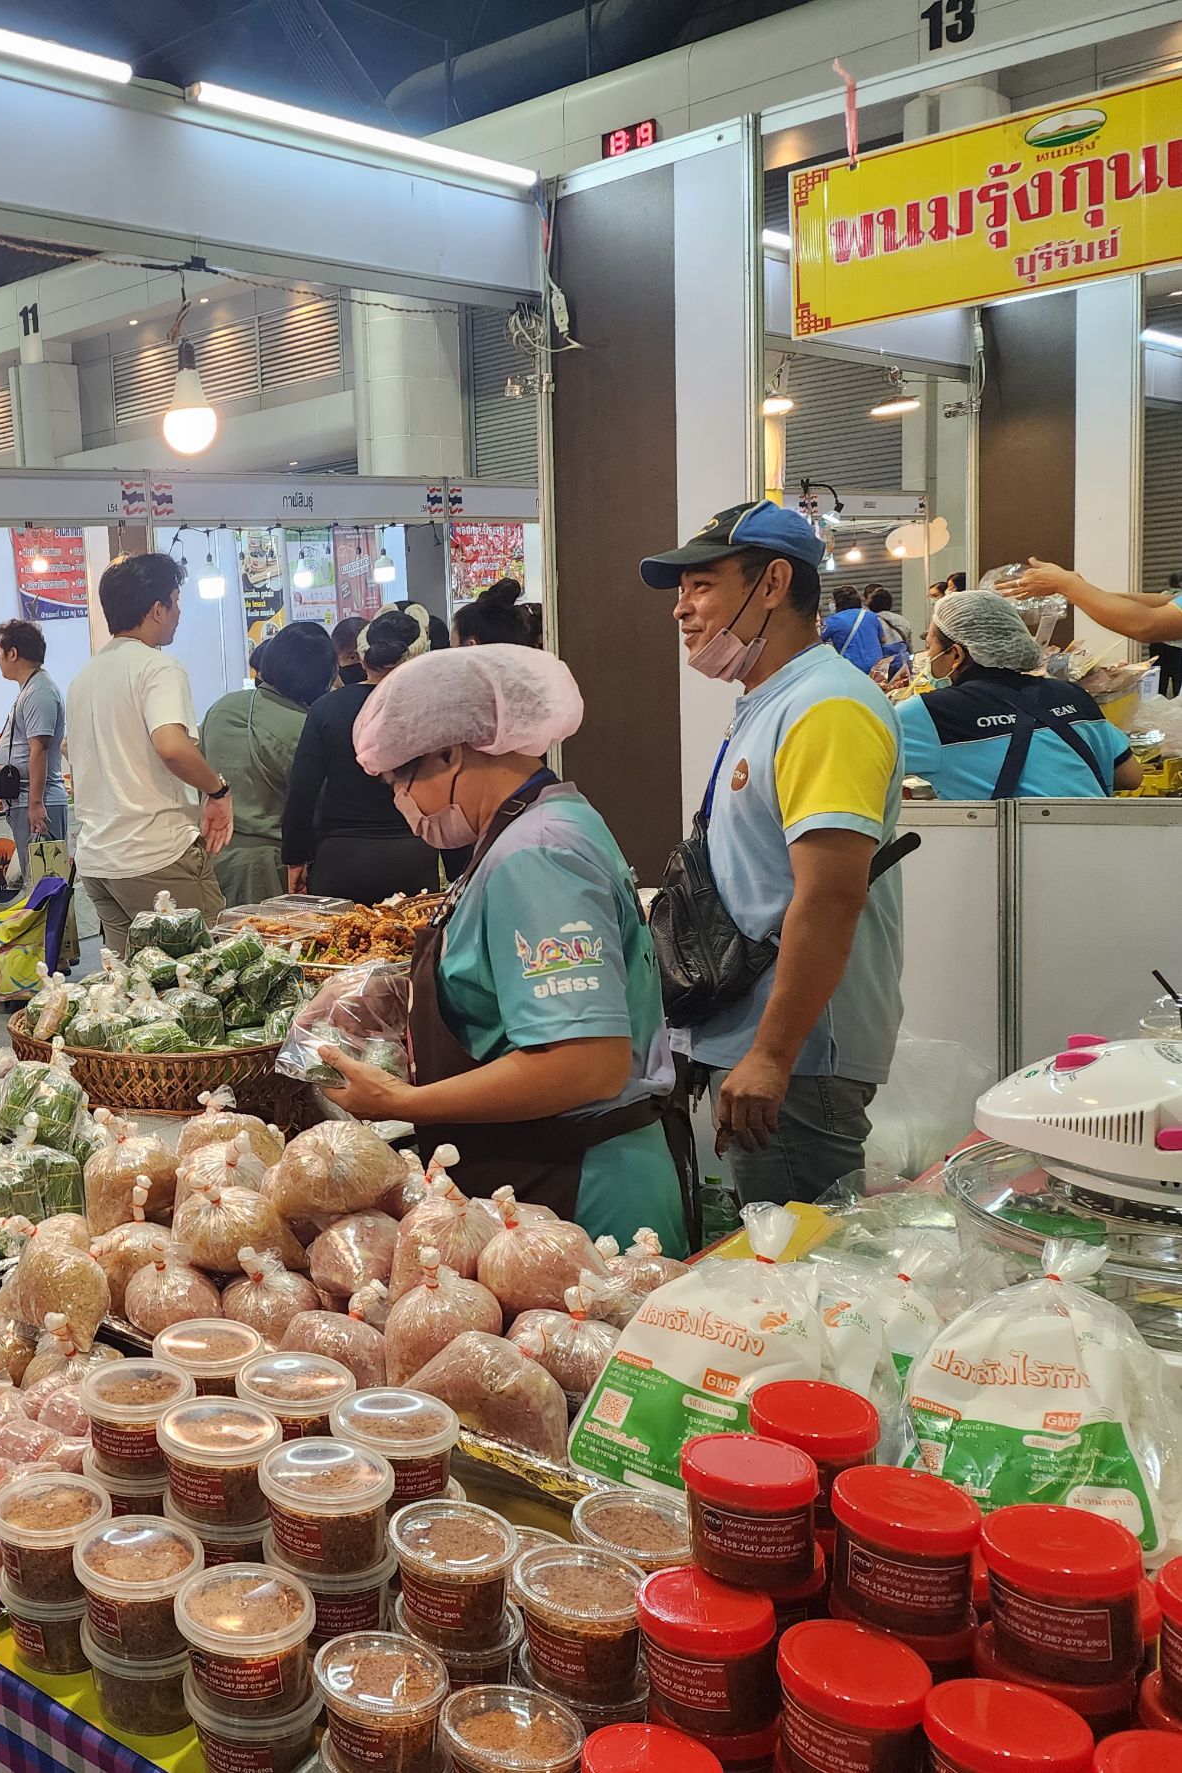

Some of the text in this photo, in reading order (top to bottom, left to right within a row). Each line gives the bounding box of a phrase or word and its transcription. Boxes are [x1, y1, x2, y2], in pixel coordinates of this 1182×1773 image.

[920, 0, 976, 51] 13
[609, 122, 653, 155] 13:19
[1015, 227, 1121, 284] บุรีรัมย์
[19, 303, 39, 336] 11
[108, 504, 118, 512] L54
[1049, 704, 1078, 717] EAN
[533, 976, 600, 999] ยโสธร
[638, 1302, 765, 1357] ปลาส้มไร้ก้าง
[705, 1373, 737, 1392] GMP
[1045, 1415, 1080, 1428] GMP
